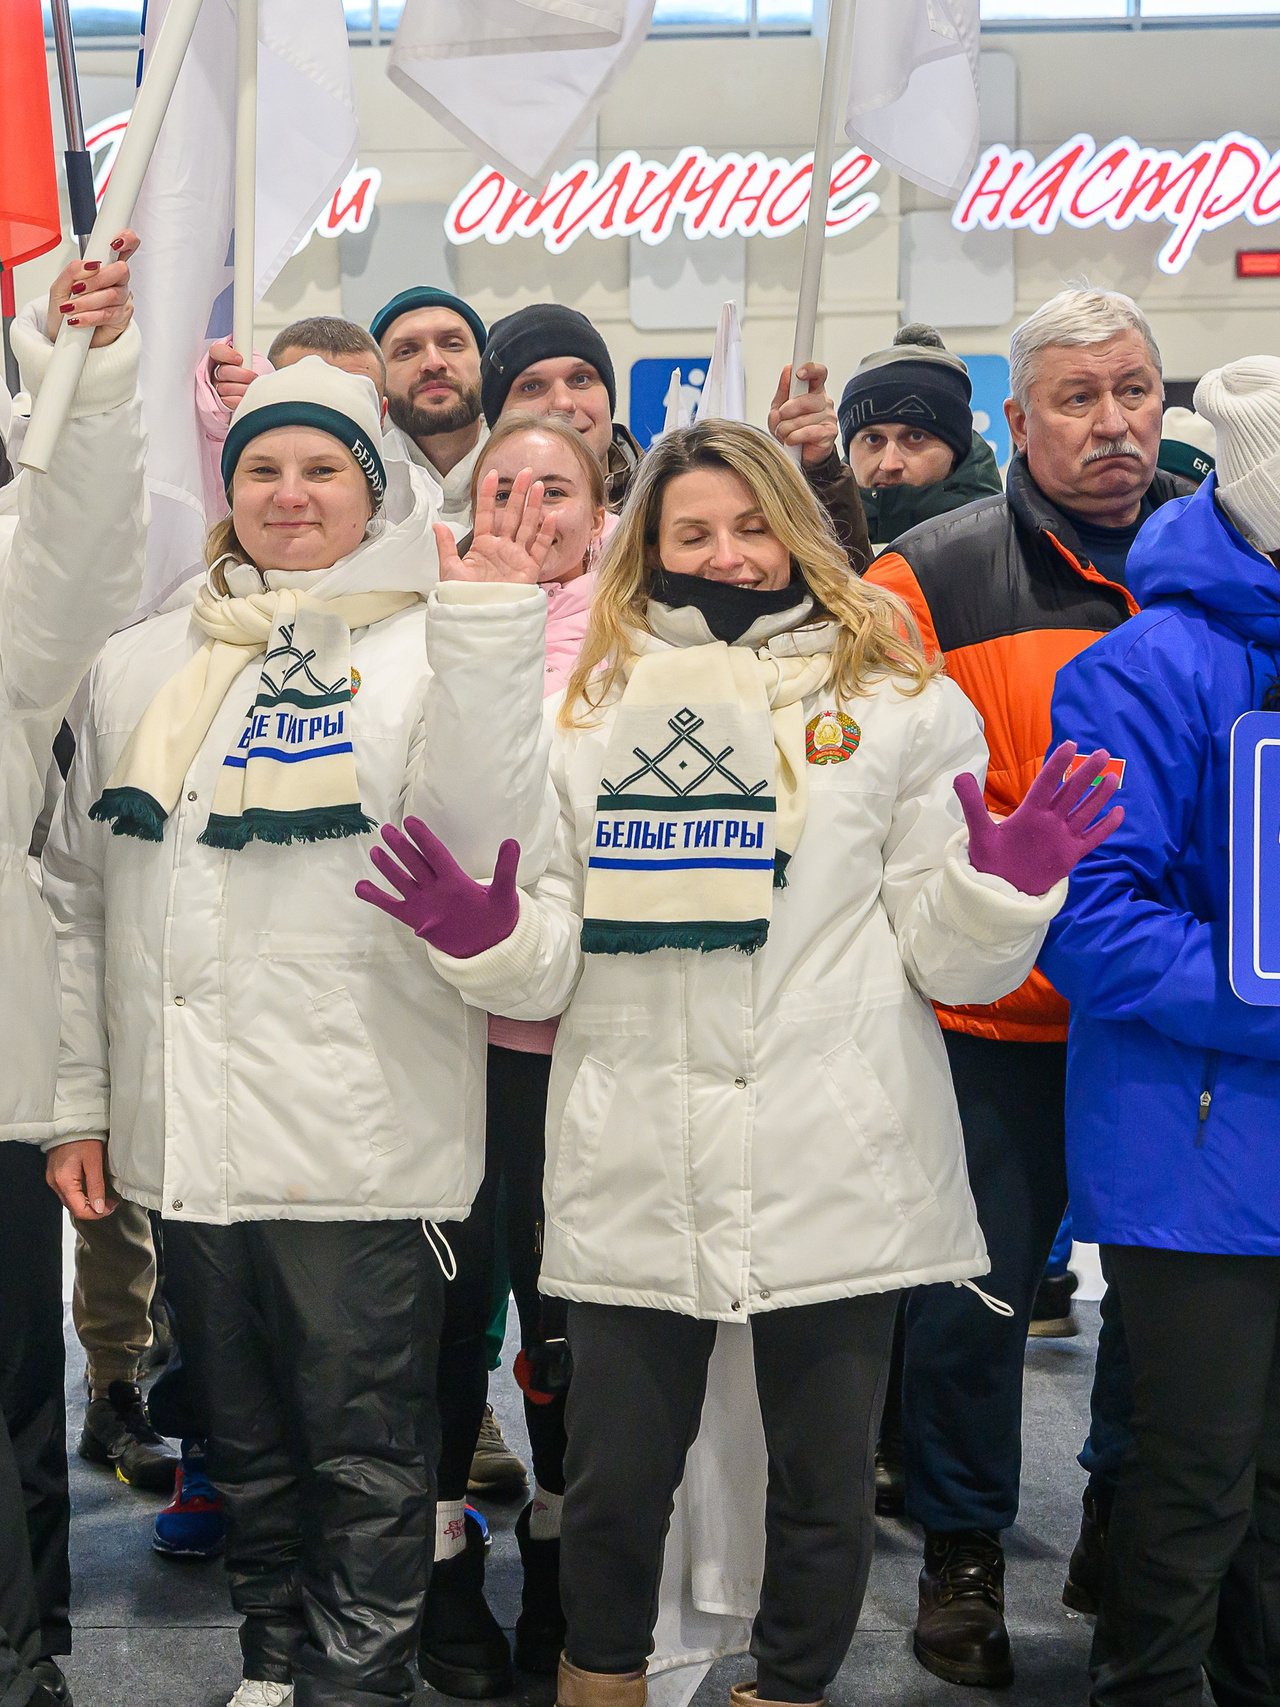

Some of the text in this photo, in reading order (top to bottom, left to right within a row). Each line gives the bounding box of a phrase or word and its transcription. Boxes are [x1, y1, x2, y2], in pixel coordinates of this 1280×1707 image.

[276, 710, 344, 744] ТИГРЫ
[596, 820, 764, 850] БЕЛЫЕ ТИГРЫ
